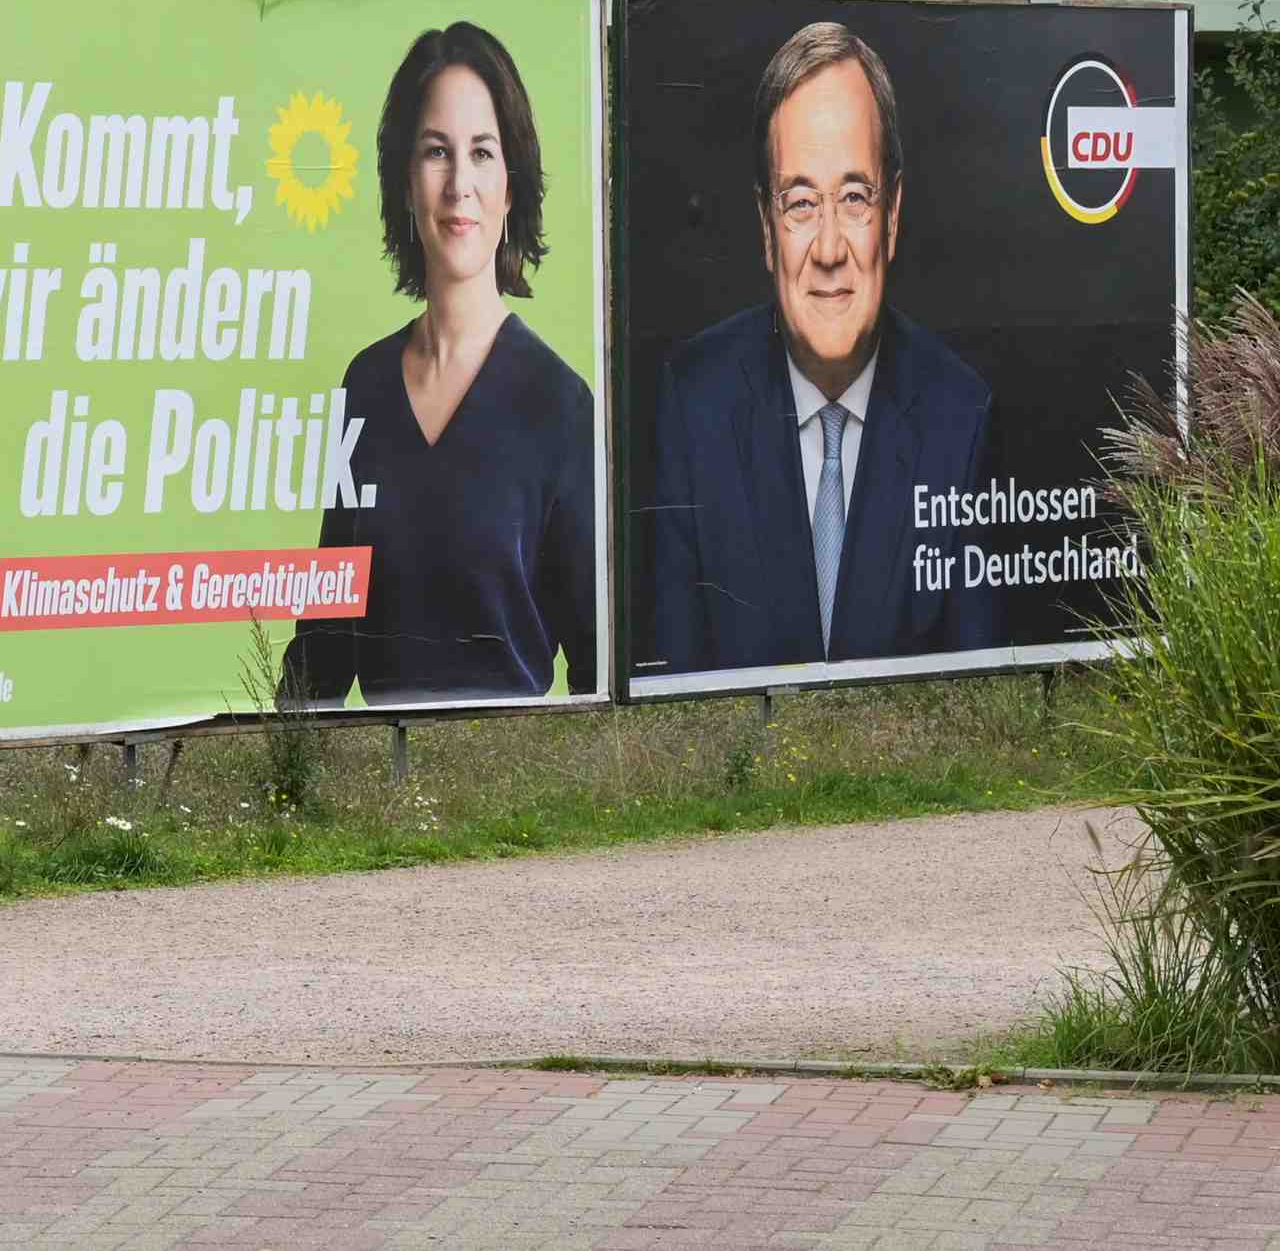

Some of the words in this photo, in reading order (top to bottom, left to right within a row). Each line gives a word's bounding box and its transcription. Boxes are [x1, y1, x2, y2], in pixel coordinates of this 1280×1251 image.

[1072, 131, 1134, 164] CDU
[75, 237, 312, 362] ändern
[19, 389, 127, 518] die
[143, 387, 377, 515] Politik.
[913, 477, 1097, 529] Entschlossen
[0, 566, 160, 618] Klimaschutz
[166, 564, 184, 611] &
[190, 561, 361, 617] Gerechtigkeit.
[913, 544, 956, 592] für
